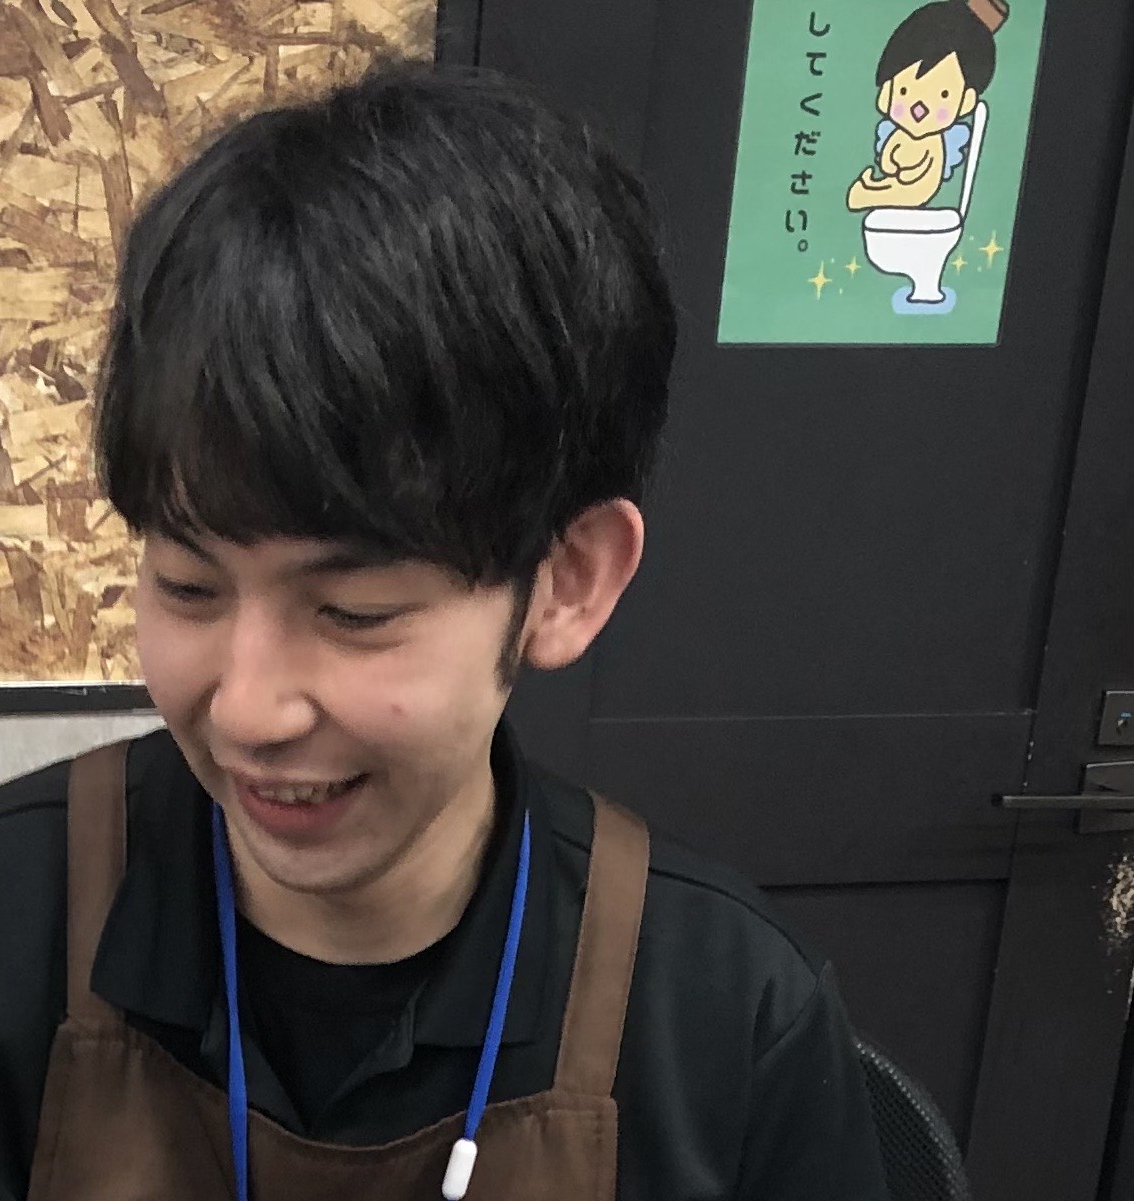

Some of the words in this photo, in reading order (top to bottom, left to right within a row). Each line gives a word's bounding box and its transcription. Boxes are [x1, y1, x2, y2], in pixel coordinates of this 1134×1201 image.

[785, 11, 830, 252] してください。
